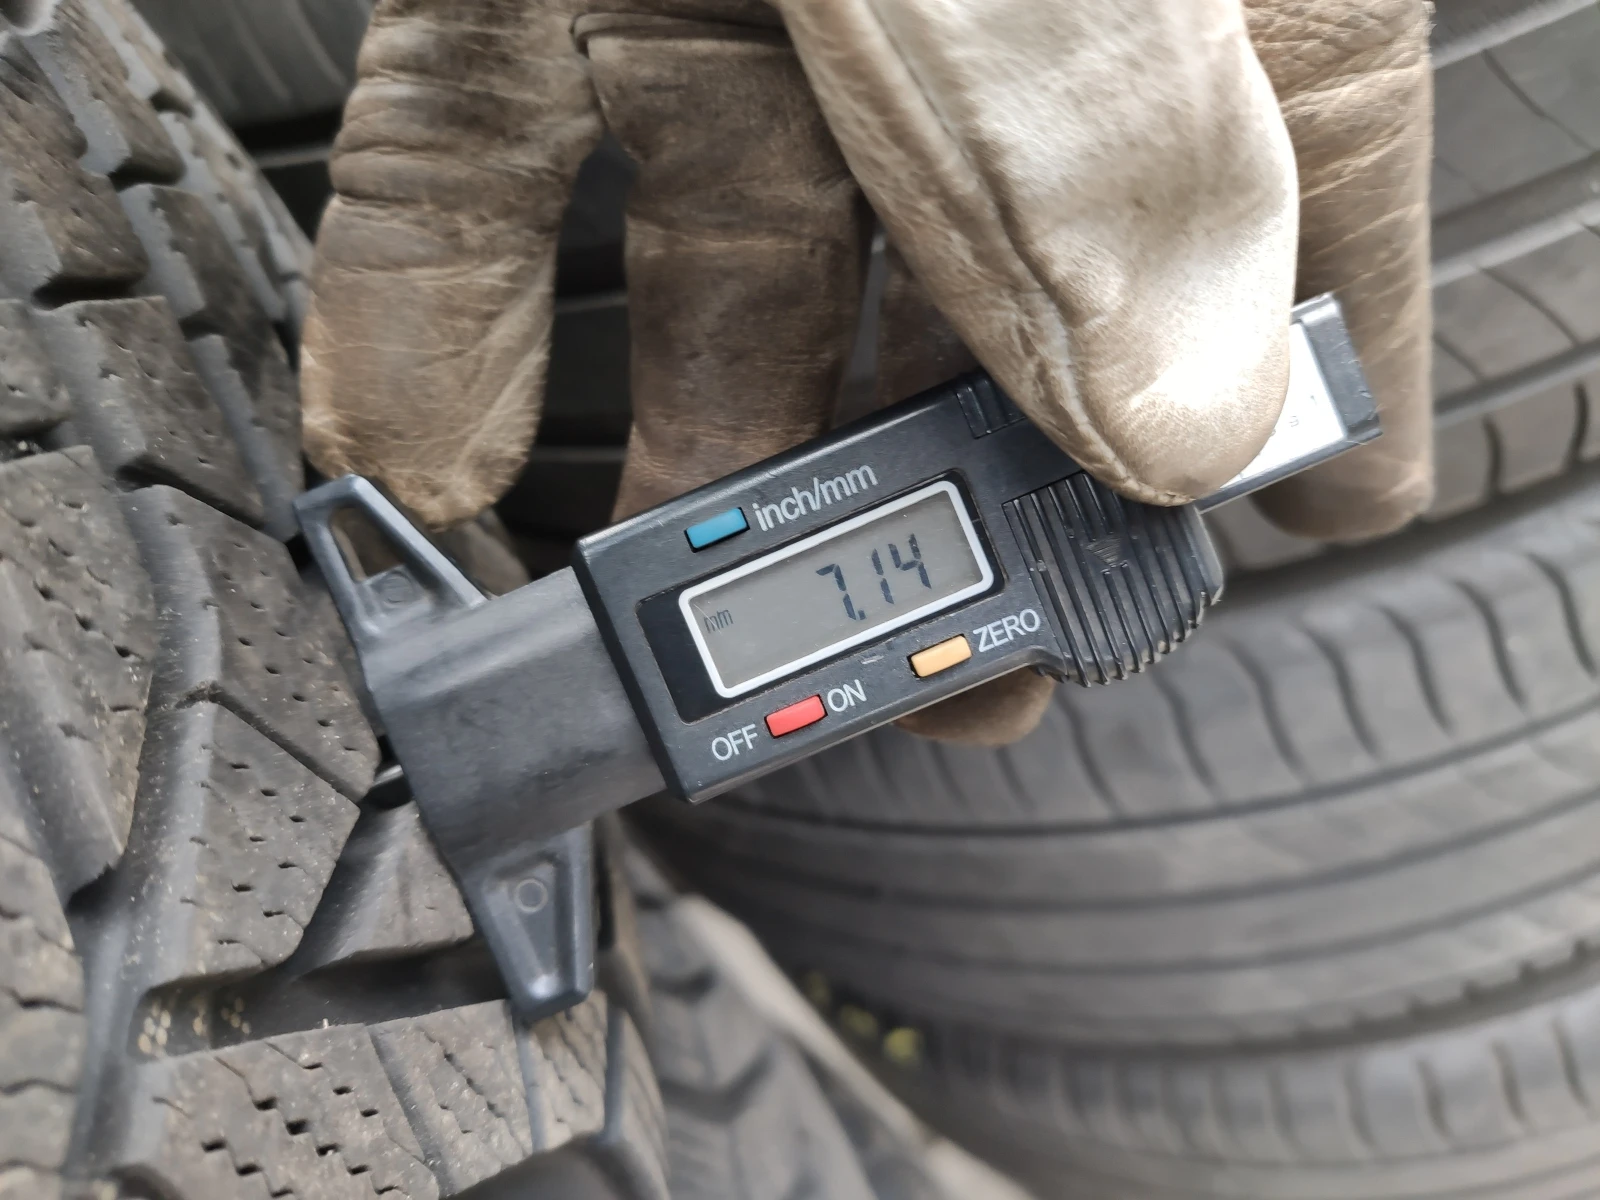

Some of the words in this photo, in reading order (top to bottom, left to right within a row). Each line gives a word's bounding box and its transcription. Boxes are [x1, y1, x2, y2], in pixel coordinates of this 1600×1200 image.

[752, 464, 878, 531] inch/mm
[815, 533, 932, 621] 7.14
[704, 608, 734, 635] mm
[972, 608, 1041, 653] ZERO
[827, 680, 867, 713] ON
[710, 725, 759, 761] OFF
